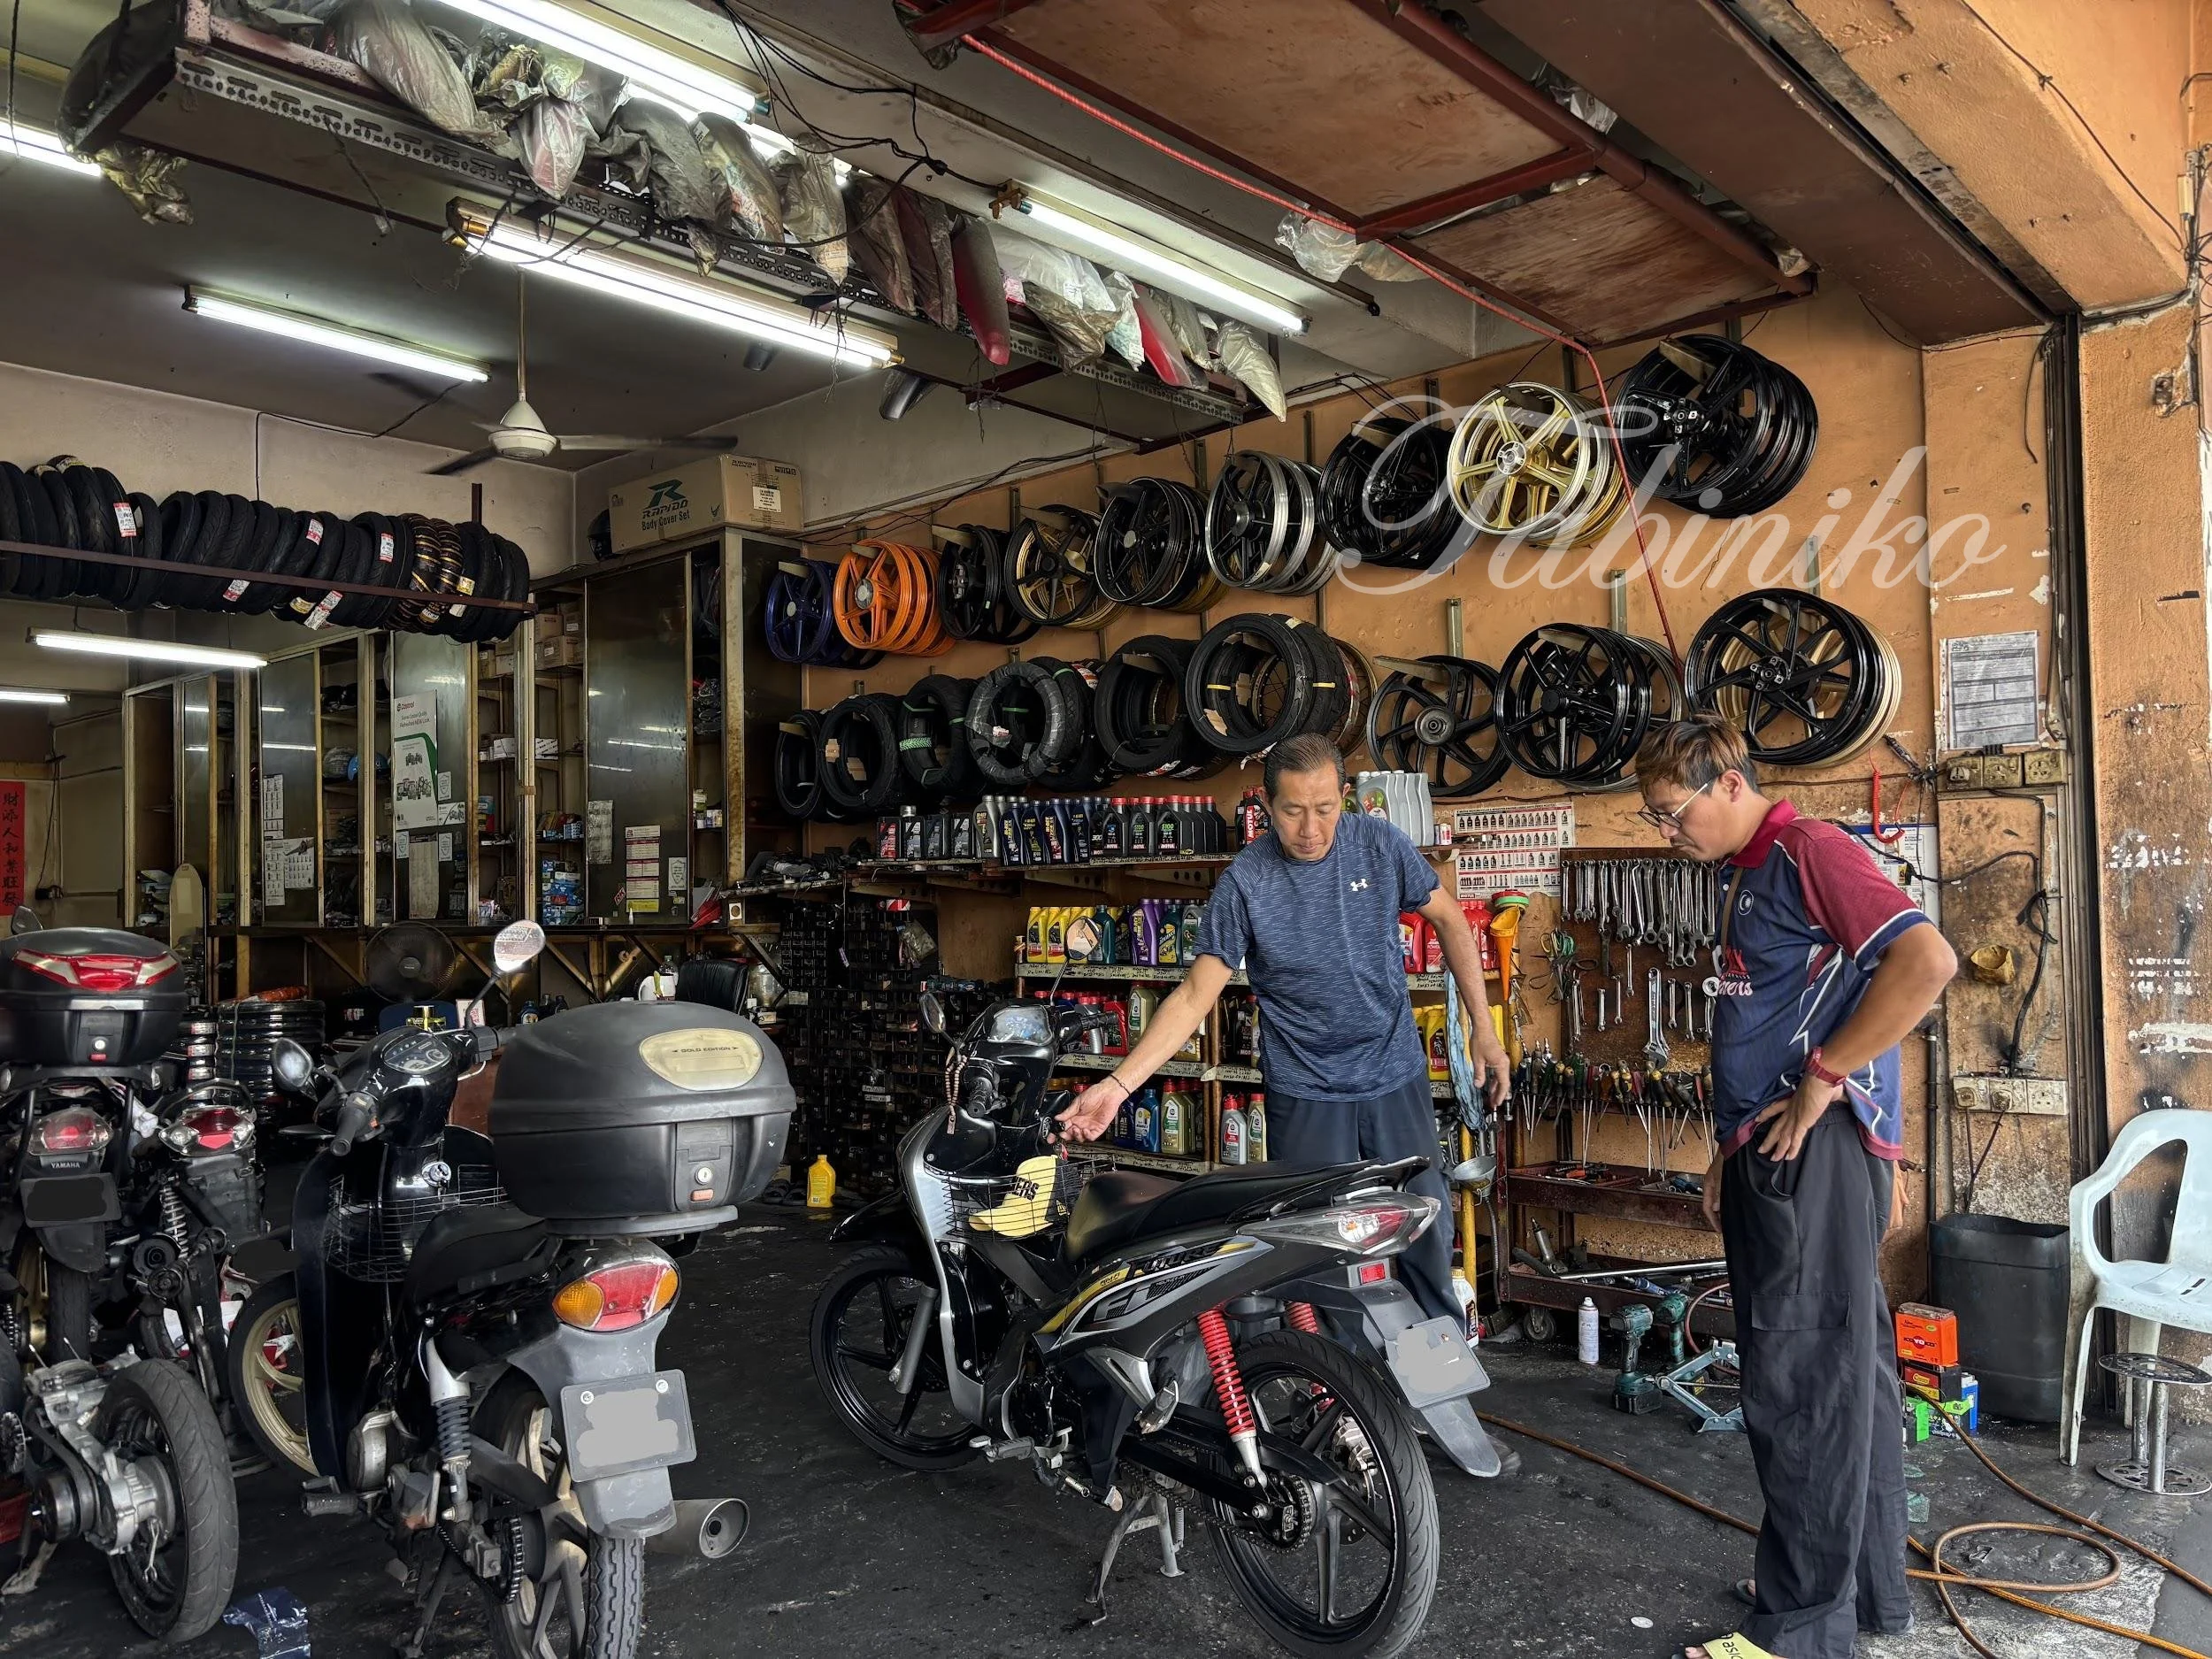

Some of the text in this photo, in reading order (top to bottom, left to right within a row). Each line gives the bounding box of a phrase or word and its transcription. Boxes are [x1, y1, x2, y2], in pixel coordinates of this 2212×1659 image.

[641, 499, 689, 519] RAPIDO
[641, 510, 690, 531] Body Cover Set
